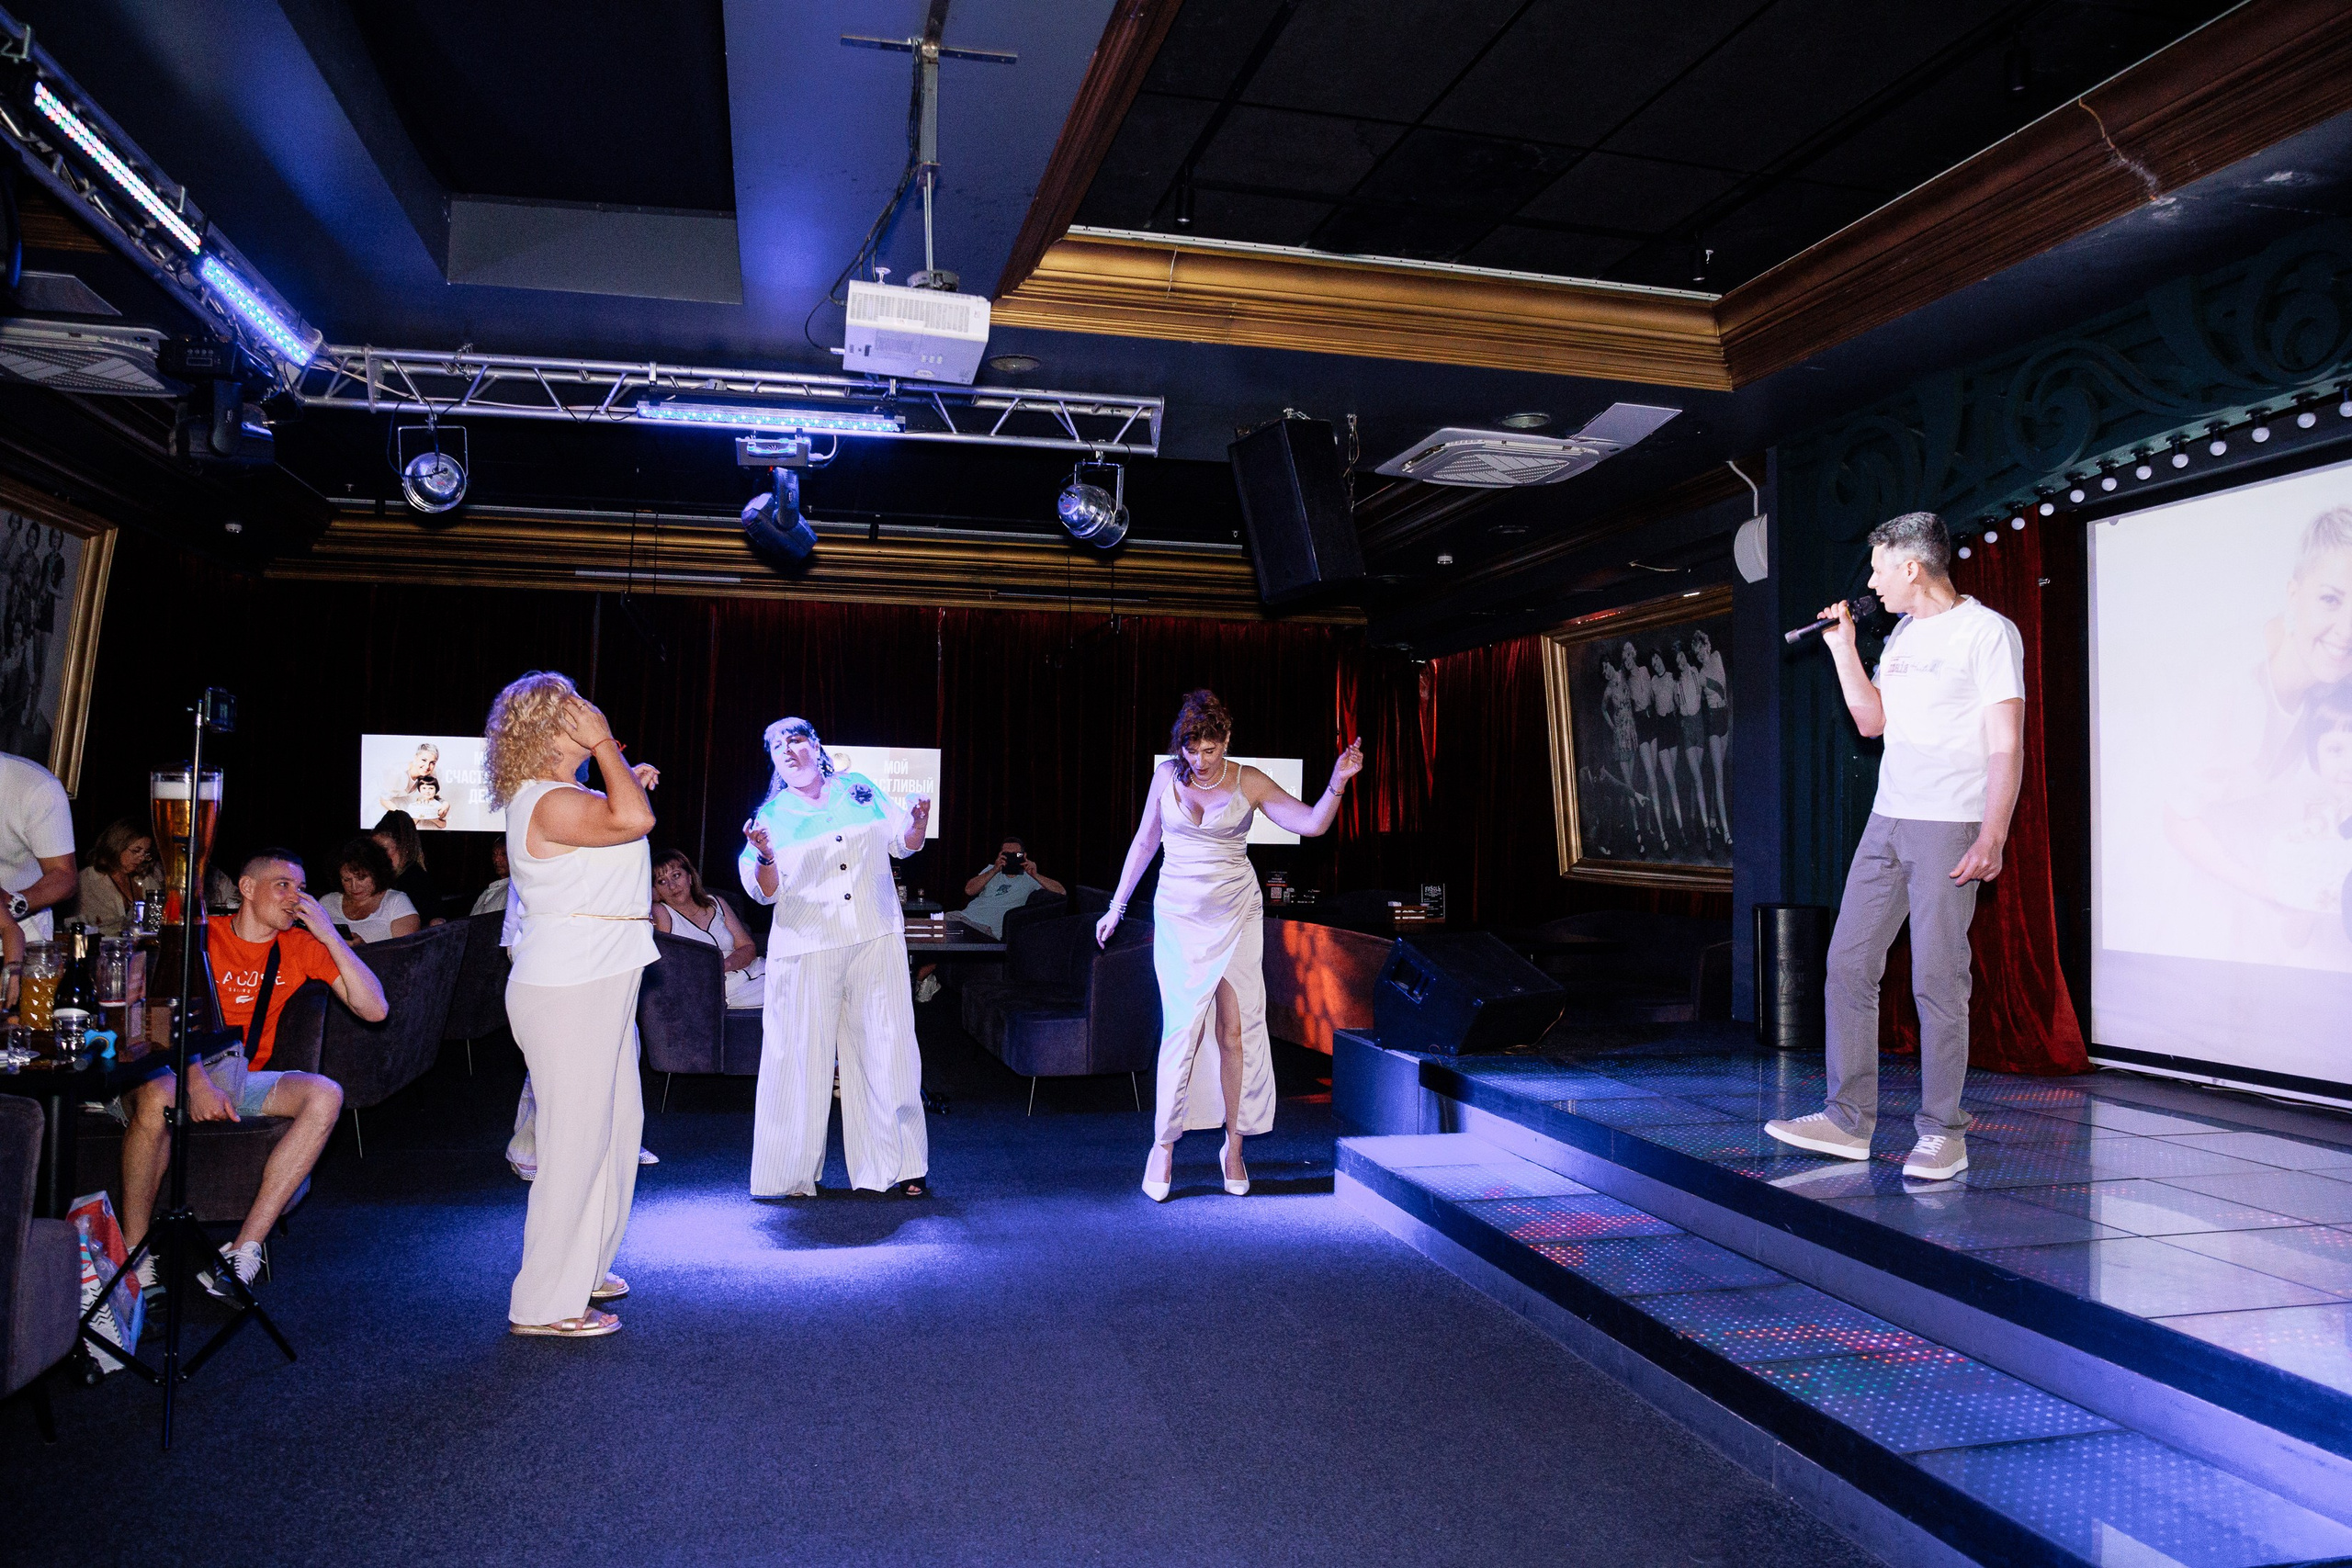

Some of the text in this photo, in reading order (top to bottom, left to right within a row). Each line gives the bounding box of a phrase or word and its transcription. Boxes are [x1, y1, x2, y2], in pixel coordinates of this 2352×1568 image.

[884, 758, 909, 774] МОЙ
[445, 769, 484, 784] СЧАСТ
[874, 776, 934, 794] СТЛИВЫЙ
[468, 788, 487, 805] ДЕ
[215, 970, 286, 987] ACOE
